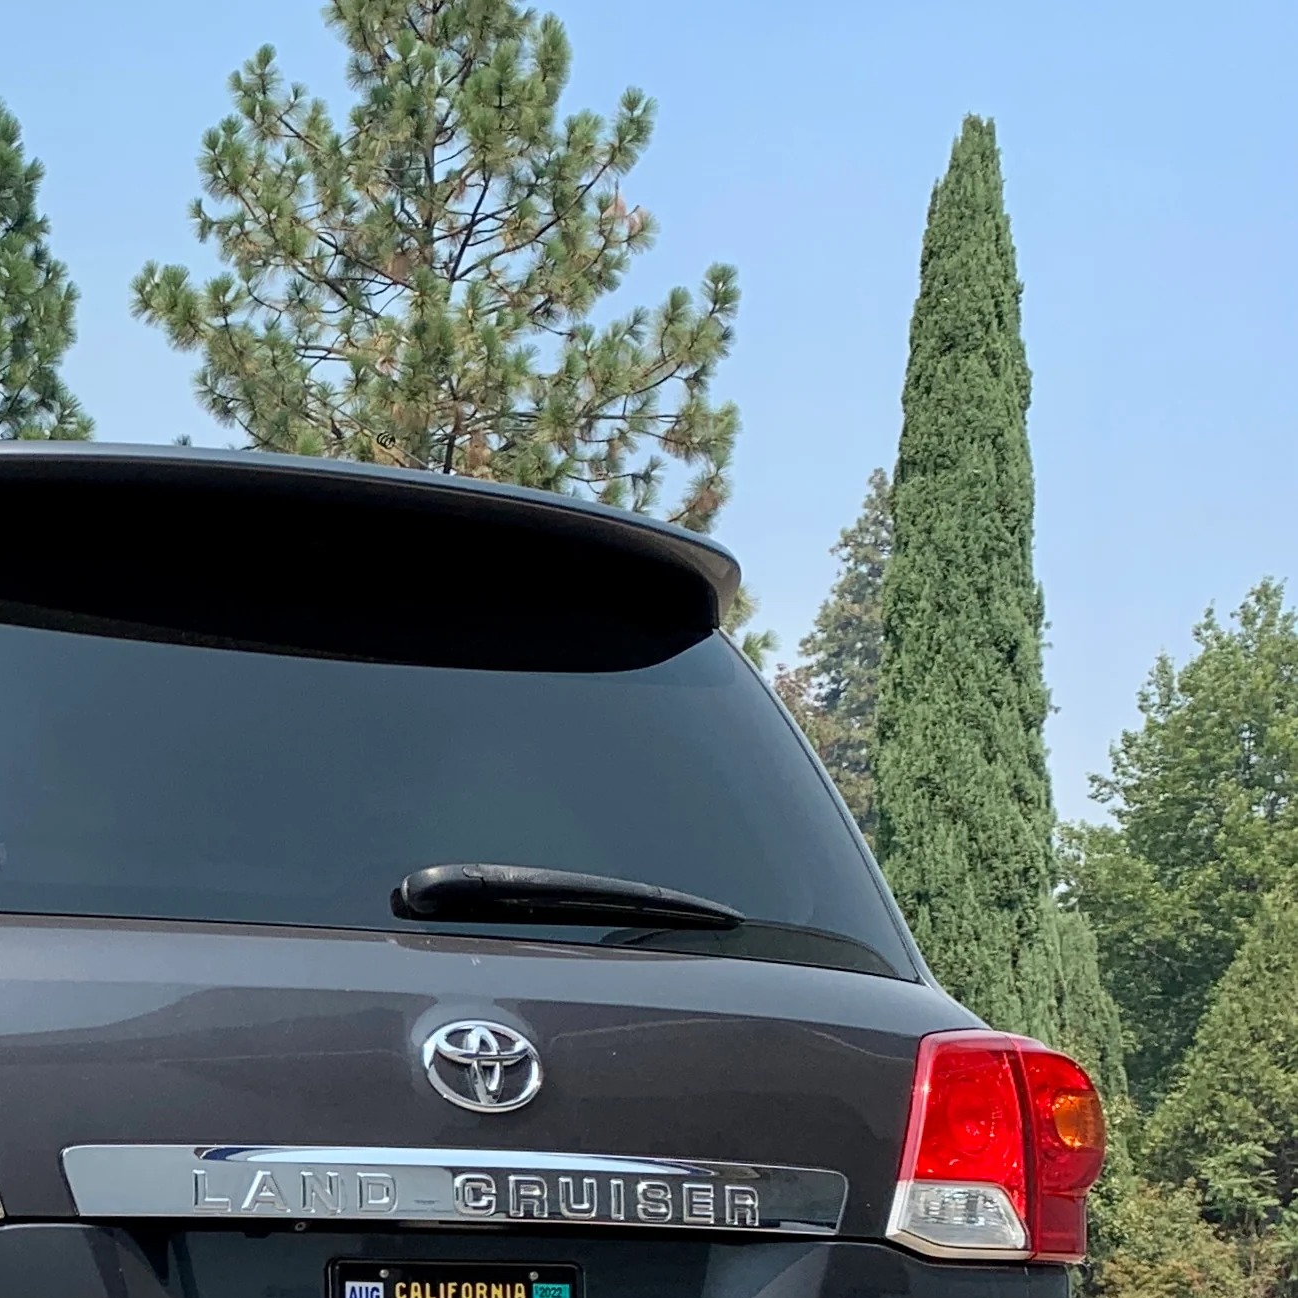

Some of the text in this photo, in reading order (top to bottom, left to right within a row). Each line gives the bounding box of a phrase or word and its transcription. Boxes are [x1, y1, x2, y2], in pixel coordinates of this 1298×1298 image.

[192, 1169, 759, 1227] LAND CRUISER
[539, 1286, 563, 1298] 2022
